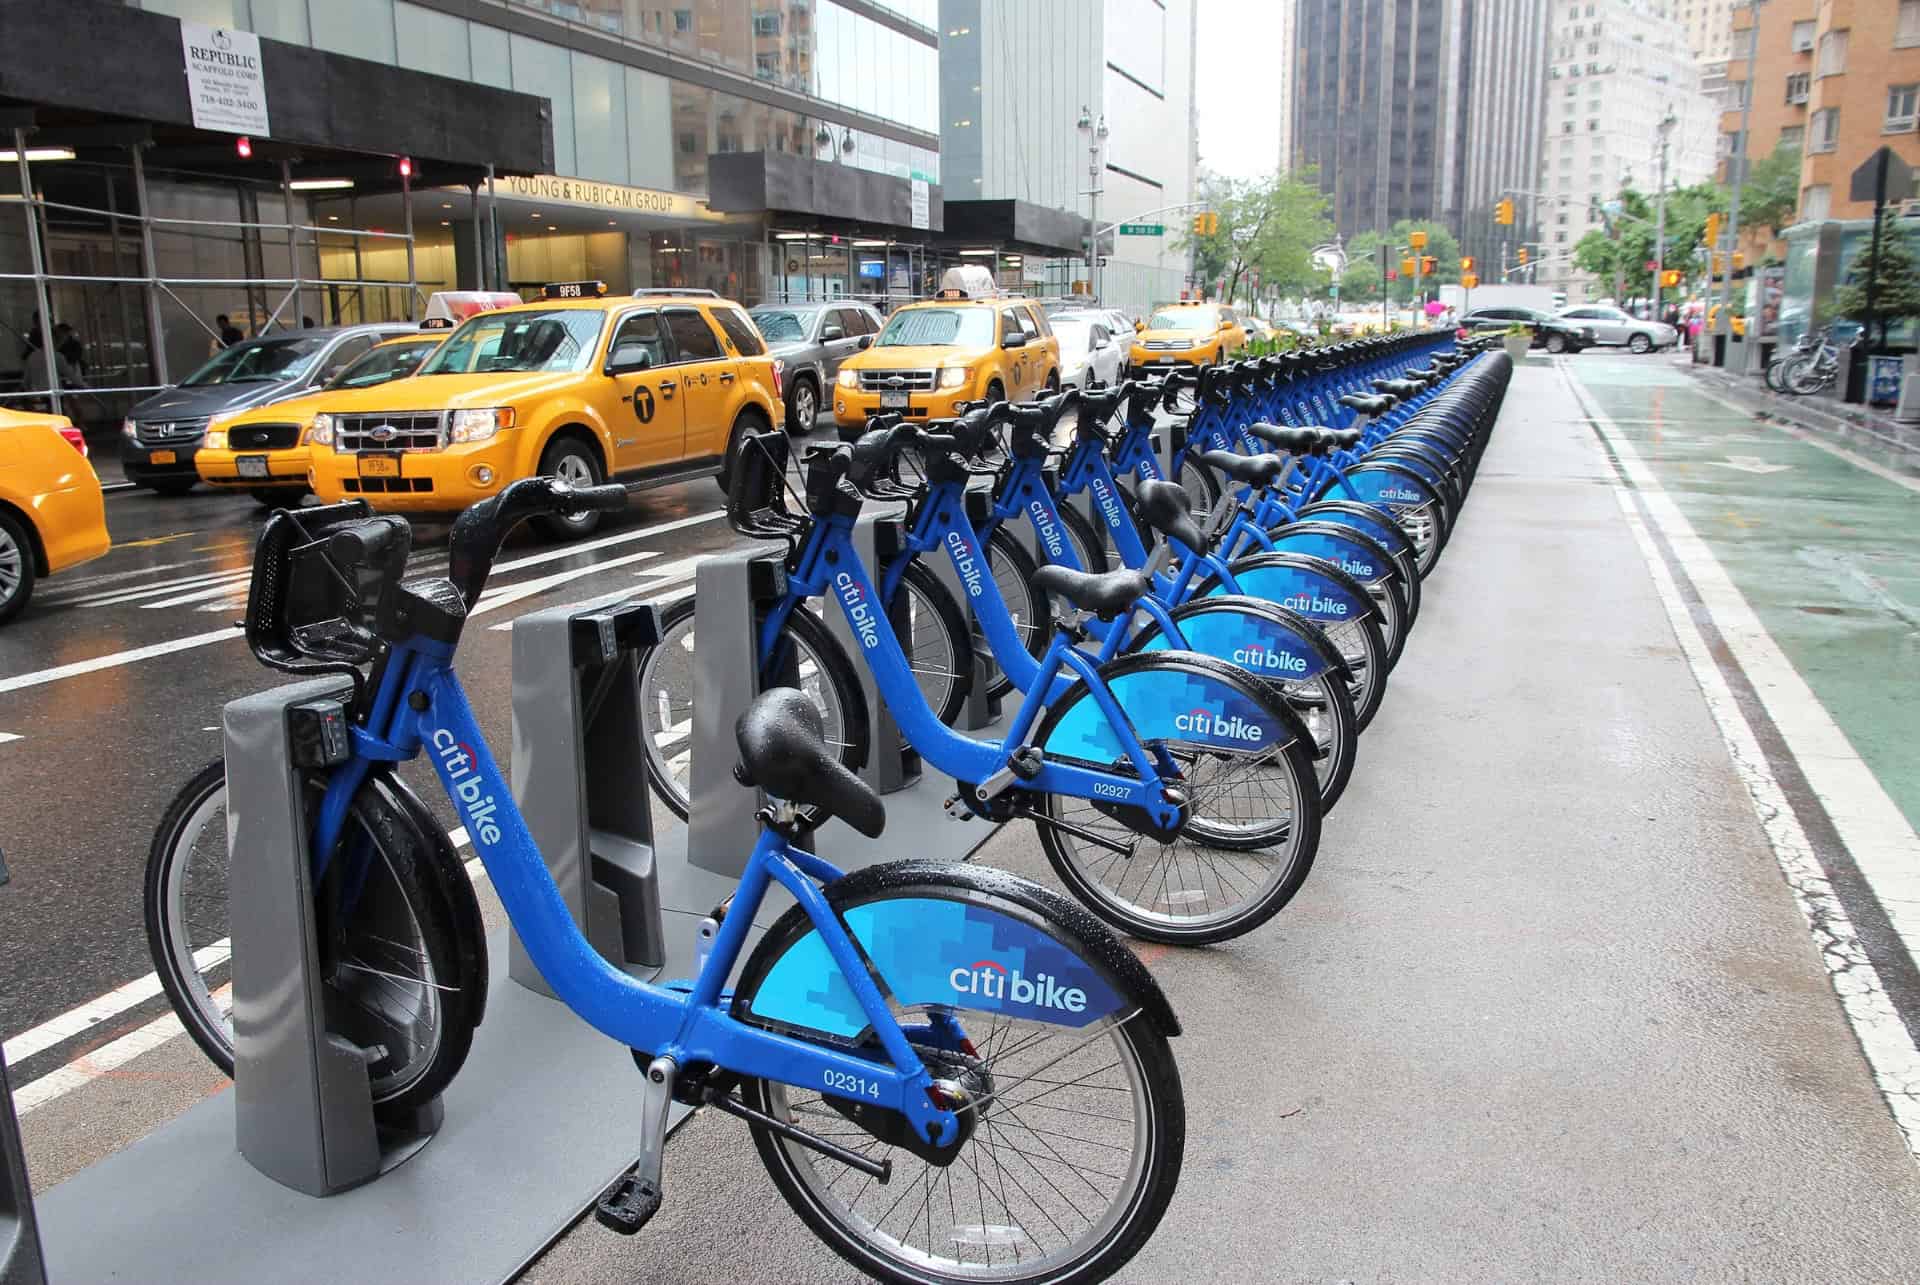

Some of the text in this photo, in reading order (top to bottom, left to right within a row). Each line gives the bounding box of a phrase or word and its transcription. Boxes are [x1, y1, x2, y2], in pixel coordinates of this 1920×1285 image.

[190, 46, 256, 69] REPUBLIC
[192, 62, 233, 77] SCAFFOLD
[510, 177, 673, 211] YOUNG & RUBICAM GROUP
[560, 285, 581, 296] 9F58
[1093, 478, 1121, 528] citi bike
[1379, 487, 1420, 501] citi bike
[1030, 501, 1062, 557] citi bike
[948, 531, 982, 597] citi bike
[1342, 560, 1372, 575] bike
[836, 572, 878, 649] citi bike
[1283, 593, 1347, 614] citi bike
[1233, 644, 1307, 672] citi bike
[1175, 708, 1262, 741] citi bike
[433, 728, 501, 846] citi bike
[1094, 782, 1131, 799] 02927
[950, 960, 1087, 1013] citi bike
[824, 1069, 880, 1098] 02314
